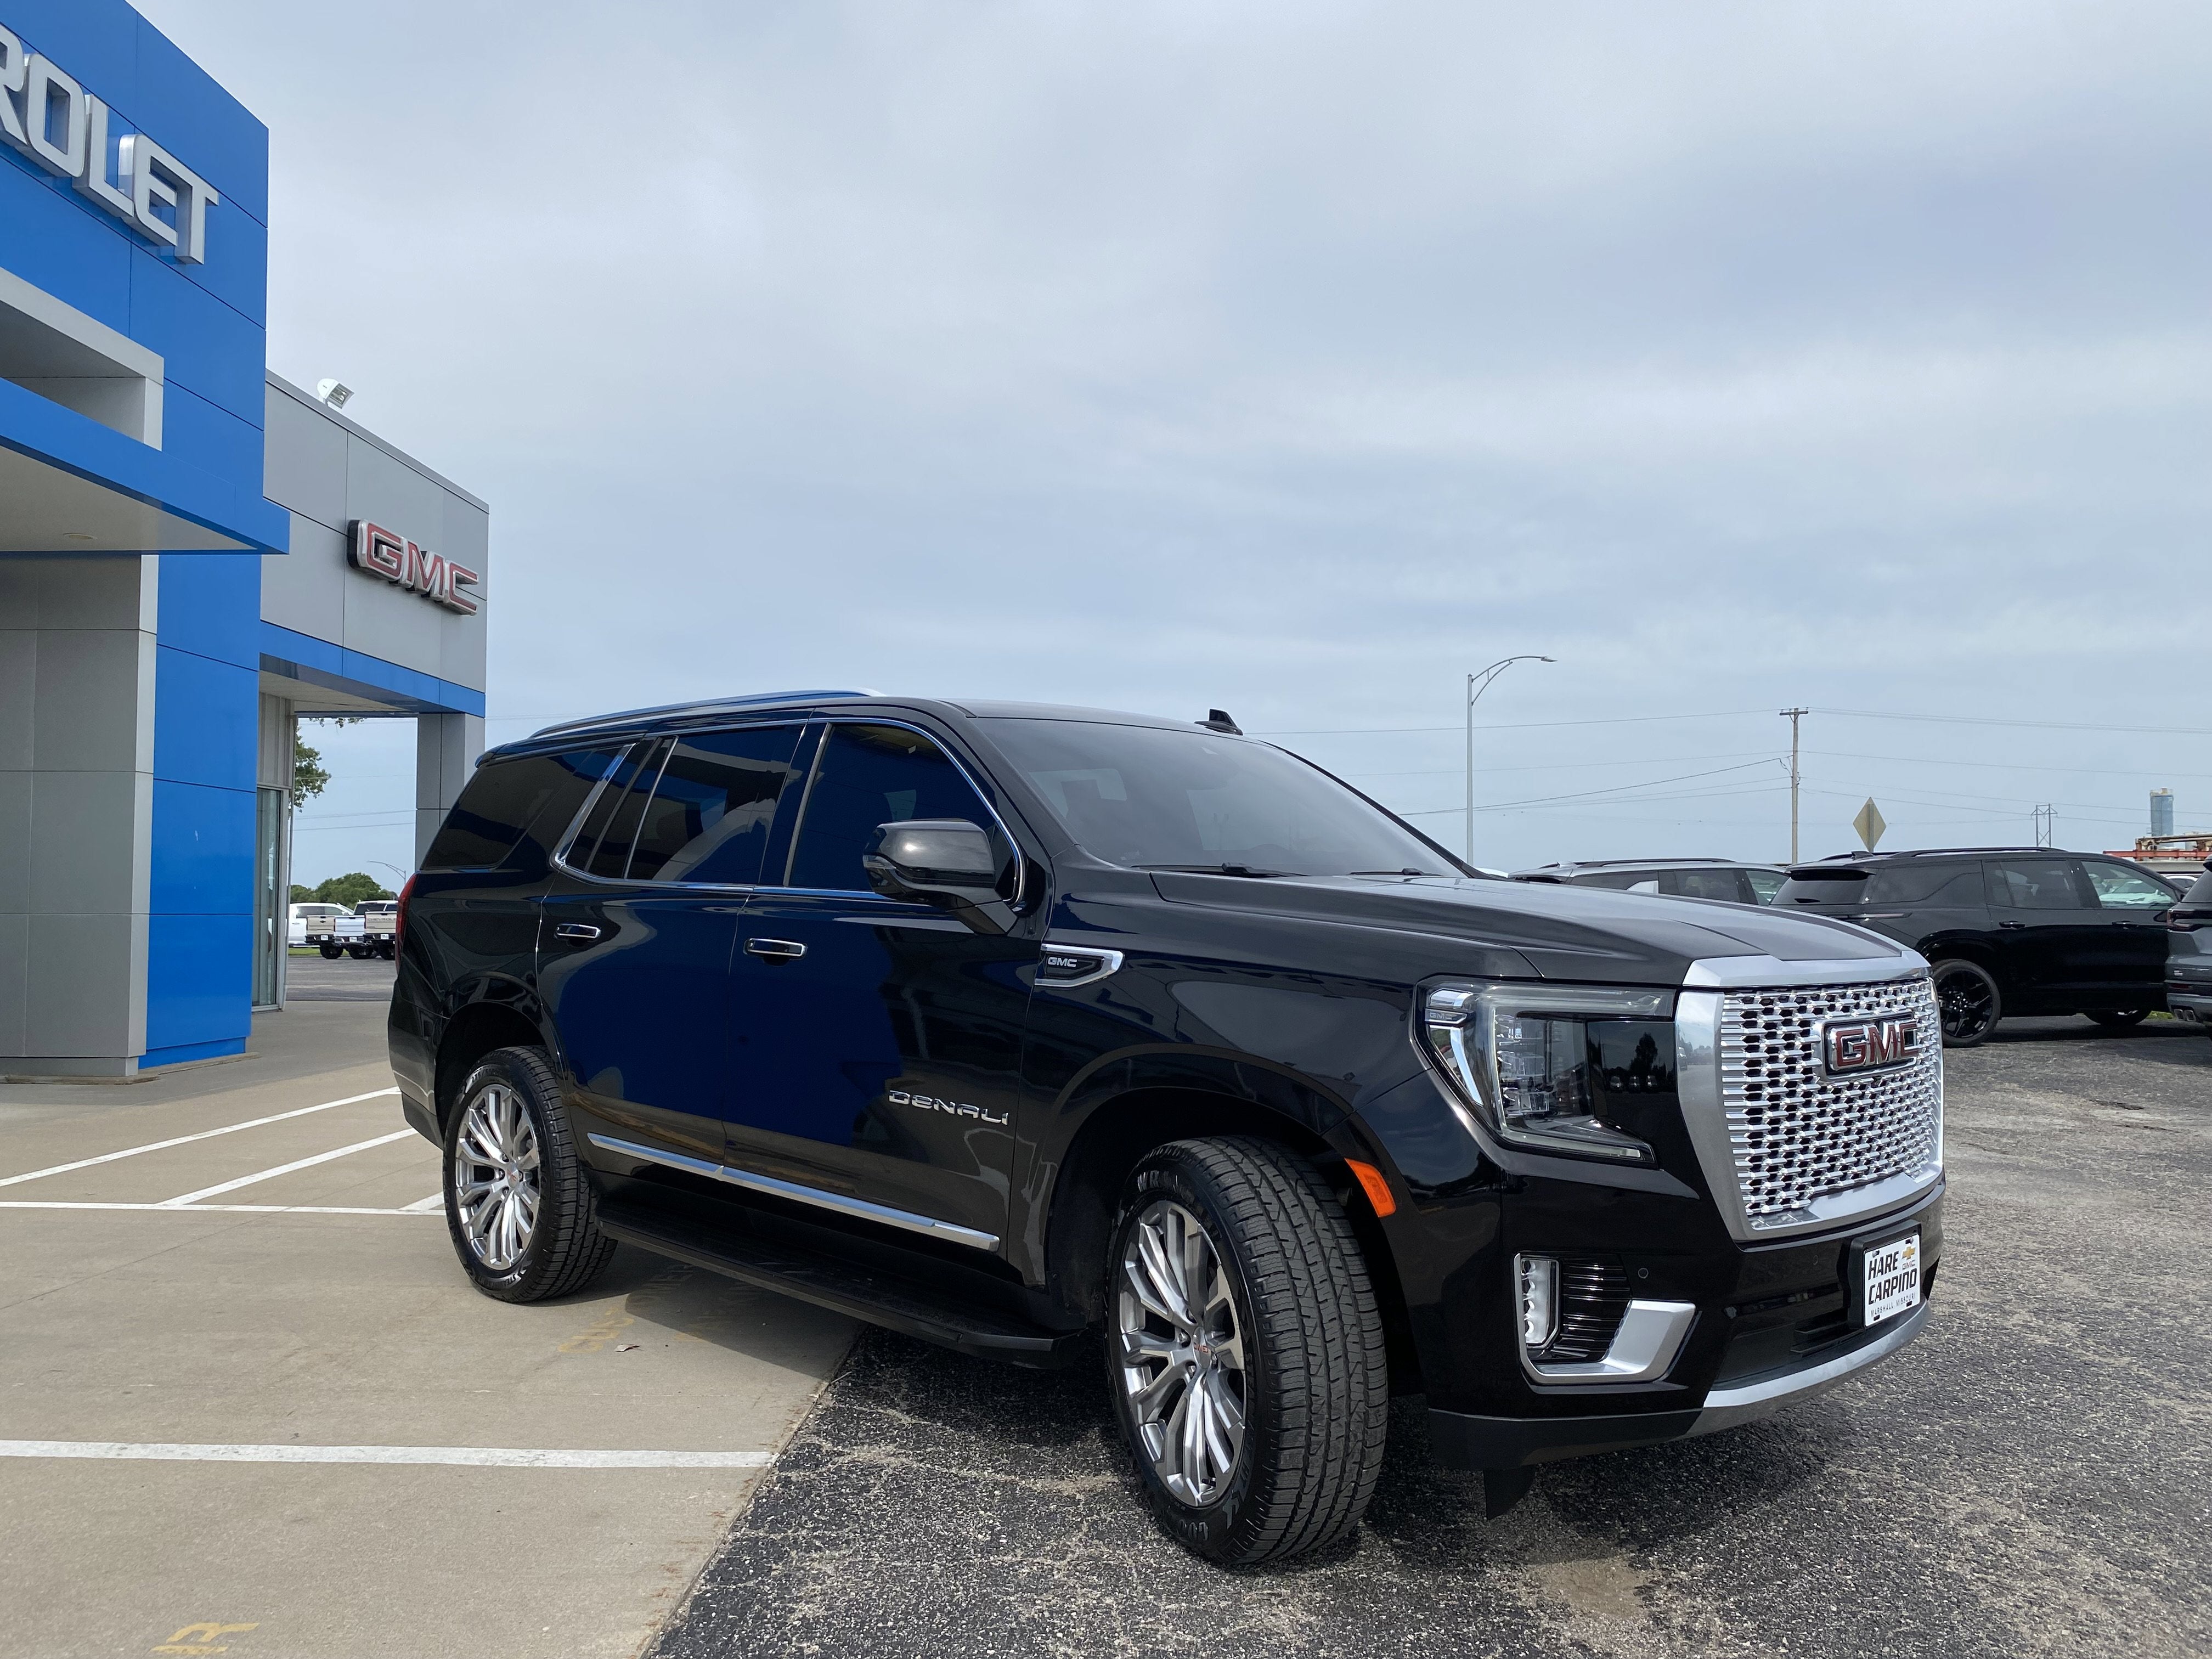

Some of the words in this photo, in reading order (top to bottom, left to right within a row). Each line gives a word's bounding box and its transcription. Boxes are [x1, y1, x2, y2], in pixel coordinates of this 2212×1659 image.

[349, 519, 479, 616] GMC
[1047, 957, 1078, 968] GMC
[1830, 1019, 1921, 1070] GMC
[889, 1090, 1009, 1125] DENALI
[1869, 1251, 1899, 1280] HARE
[1902, 1260, 1916, 1271] GMC
[1869, 1268, 1917, 1305] CARPINO
[1896, 1293, 1916, 1306] MISSOURI
